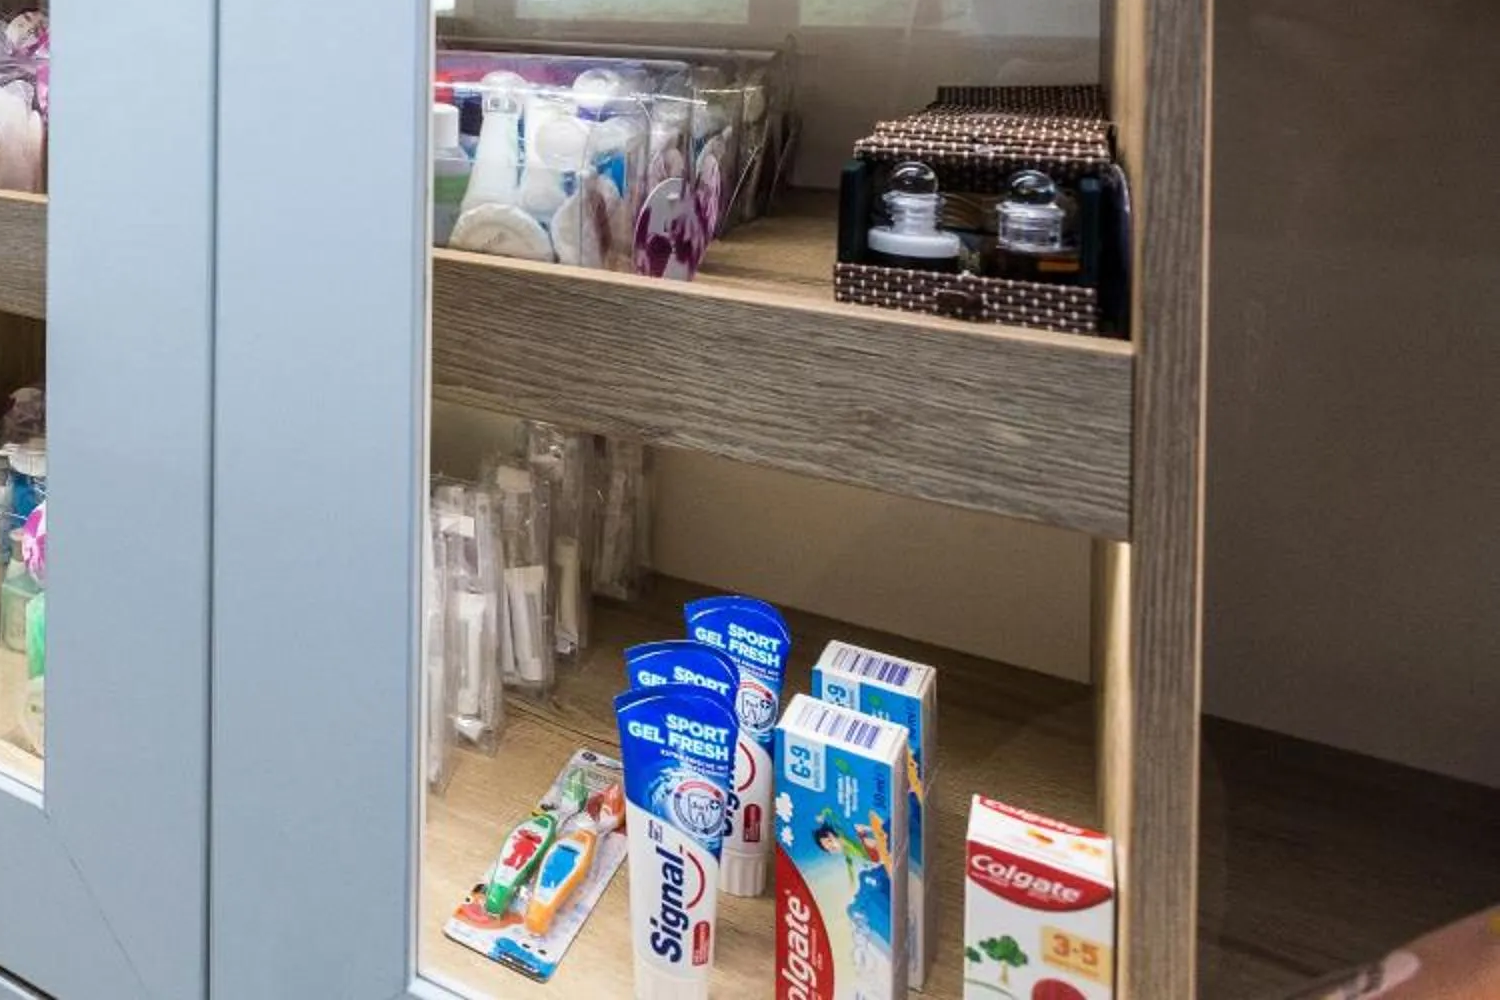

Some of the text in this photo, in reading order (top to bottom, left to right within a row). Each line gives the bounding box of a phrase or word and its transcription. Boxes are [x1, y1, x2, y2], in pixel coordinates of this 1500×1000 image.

[695, 626, 726, 649] GEL
[728, 639, 781, 668] FRESH
[728, 622, 781, 652] SPORT
[673, 665, 730, 695] SPORT
[627, 720, 729, 762] GEL FRESH
[665, 713, 730, 744] SPORT
[971, 854, 1083, 903] Colgate
[650, 846, 689, 963] Signal
[781, 895, 817, 1000] olgate
